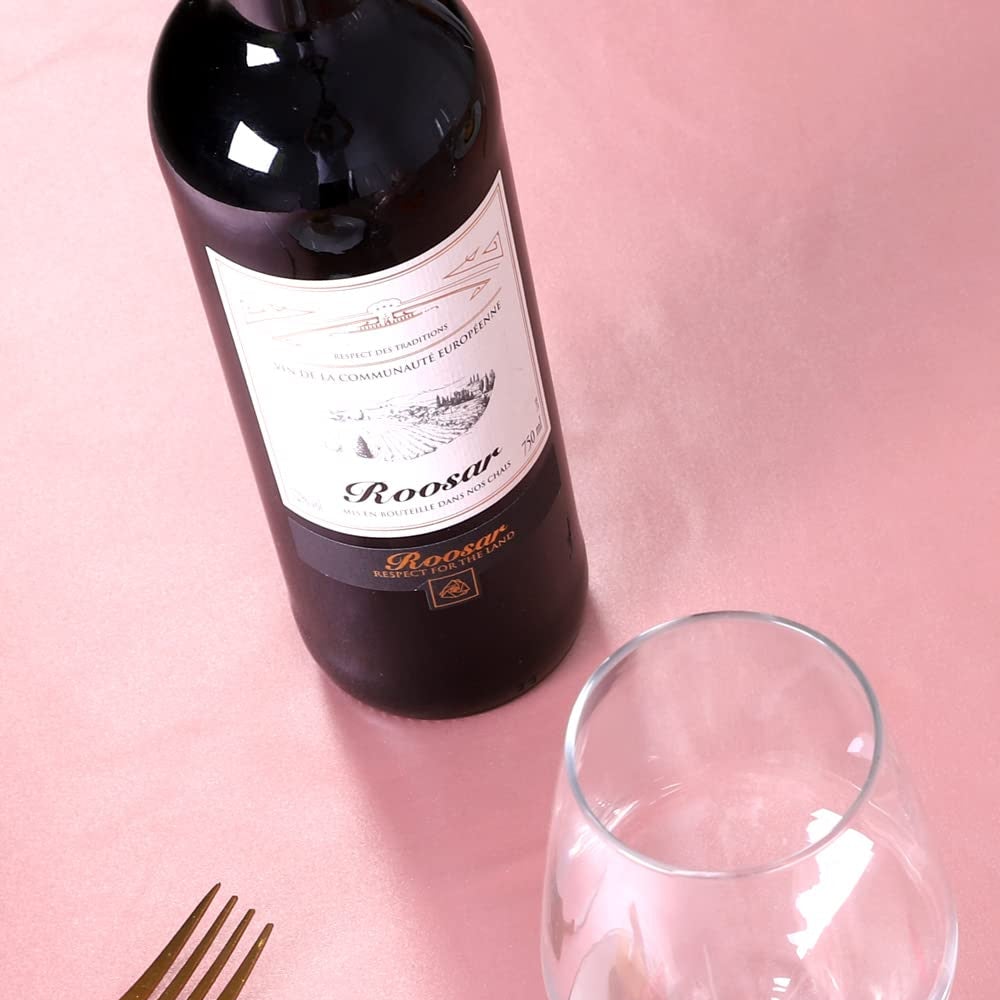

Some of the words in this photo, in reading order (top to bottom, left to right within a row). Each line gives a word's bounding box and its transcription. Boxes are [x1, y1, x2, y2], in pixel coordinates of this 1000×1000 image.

[333, 350, 373, 361] RESPECT
[375, 346, 394, 357] DES
[395, 323, 449, 351] TRADITIONS
[338, 353, 436, 383] COMMUNAUTÉ
[438, 302, 503, 359] EUROPÉENNE
[521, 430, 536, 456] 750
[343, 446, 503, 504] Roosar
[381, 503, 435, 518] BOUTEILLE
[437, 493, 466, 508] DANS
[466, 482, 486, 498] NOS
[487, 461, 512, 486] CHAIS
[373, 568, 427, 579] RESPECT
[431, 561, 456, 575] FOR
[457, 551, 484, 567] THE
[486, 529, 516, 555] LAND
[385, 523, 509, 572] Roosar
